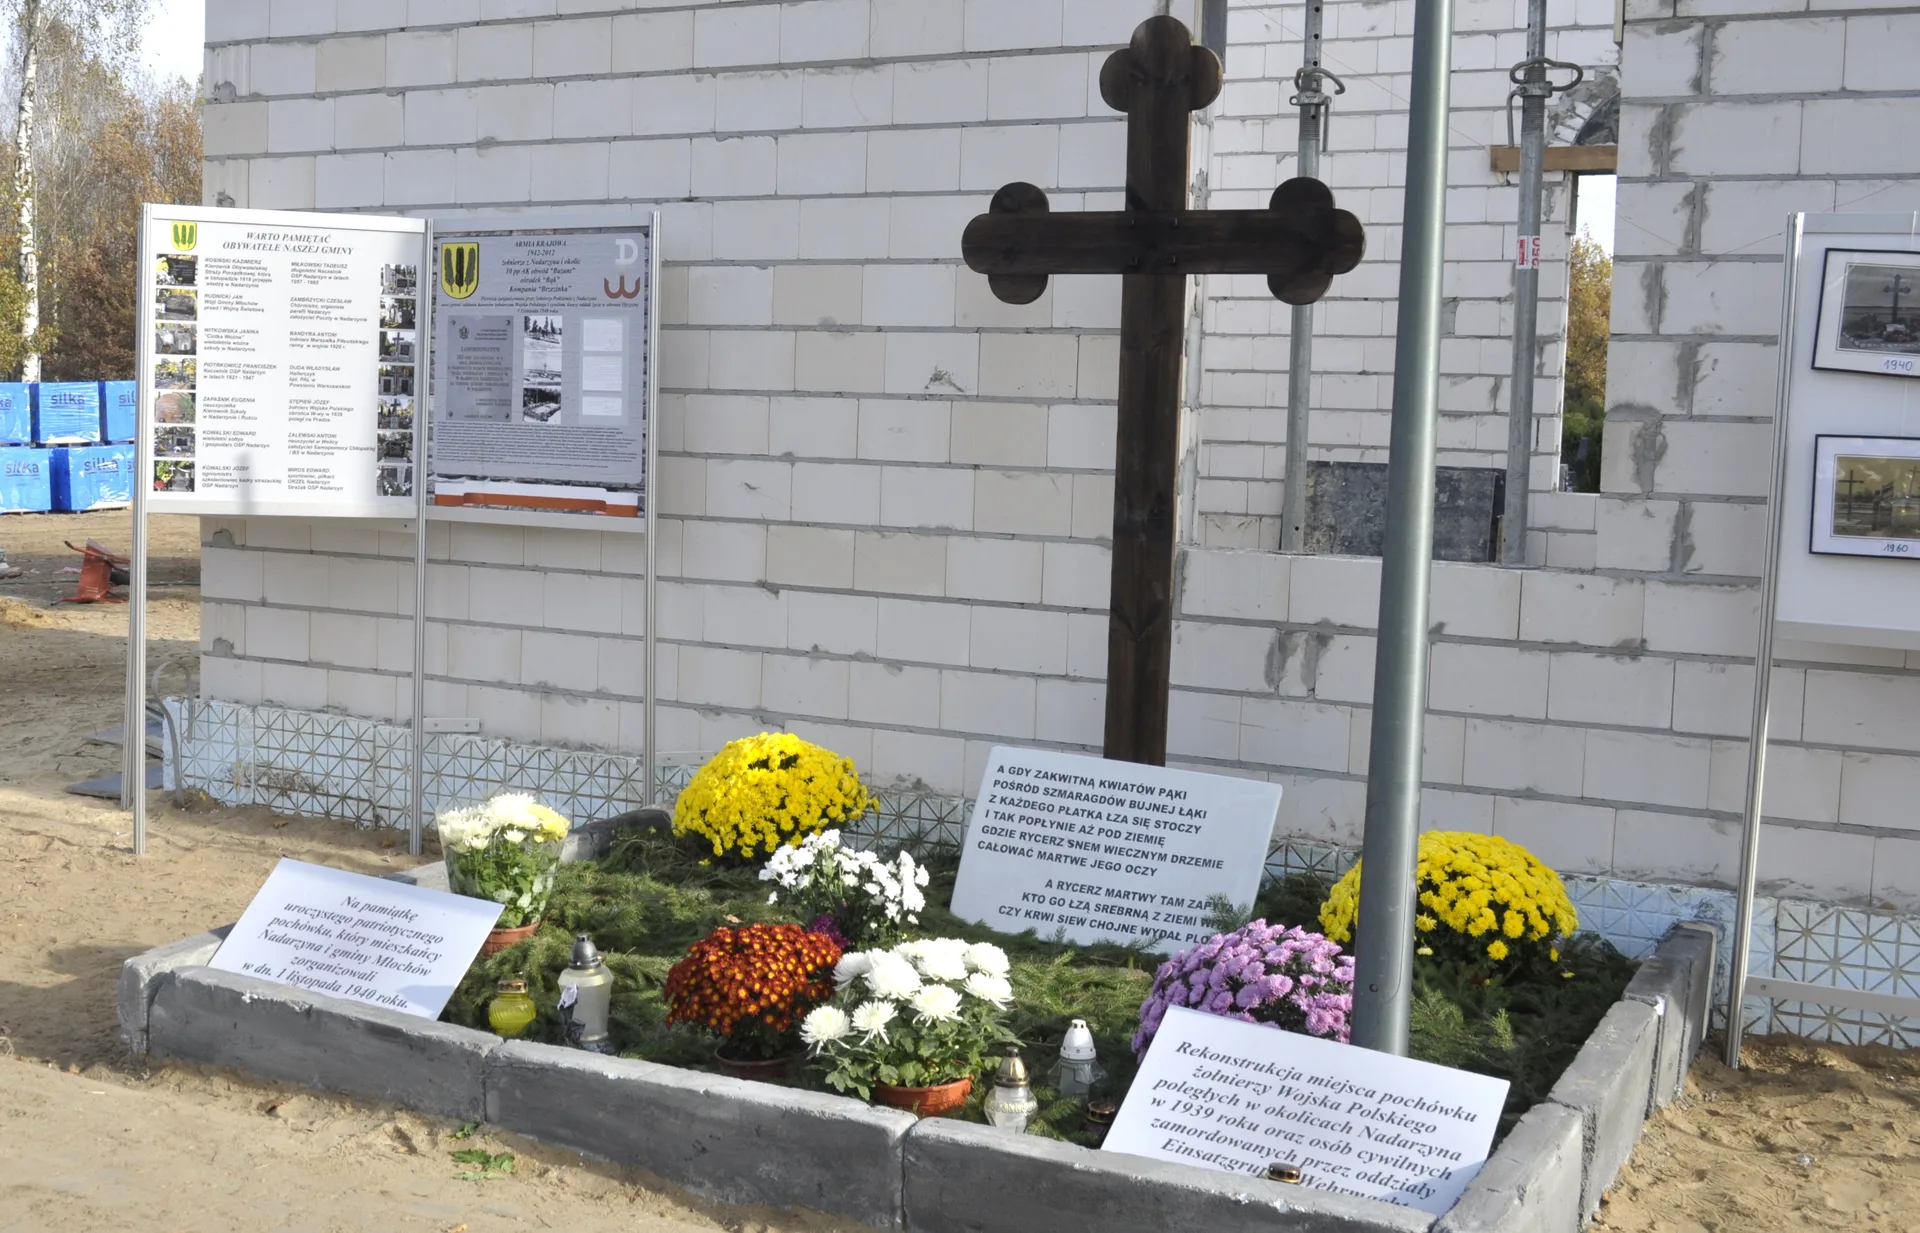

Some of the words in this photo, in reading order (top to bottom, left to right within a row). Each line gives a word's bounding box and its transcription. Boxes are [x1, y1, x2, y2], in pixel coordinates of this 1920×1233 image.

[222, 241, 280, 251] OBYWATELE
[283, 244, 319, 253] NASZEJ
[321, 246, 353, 254] GMINY
[246, 232, 280, 240] WARTO
[282, 233, 331, 244] PAMIĘTAĆ
[1883, 359, 1913, 371] 1940
[51, 392, 85, 405] silka
[5, 461, 39, 473] silka
[1883, 543, 1909, 552] 1960
[992, 779, 1039, 794] POŚRÓD
[1042, 786, 1126, 807] SZMARAGDÓW
[1128, 799, 1175, 814] BUJNEJ
[1178, 806, 1207, 820] ŁĄKI
[996, 764, 1004, 773] A
[1008, 766, 1031, 776] GDY
[1033, 769, 1095, 789] ZAKWITNĄ
[1098, 779, 1155, 795] KWIATÓW
[1158, 787, 1187, 800] PĄKI
[985, 809, 989, 818] I
[993, 810, 1015, 822] TAK
[1018, 814, 1076, 832] POPŁYNIE
[1077, 824, 1094, 835] AŻ
[1097, 827, 1121, 839] POD
[1124, 831, 1165, 848] ZIEMIĘ
[988, 794, 997, 803] Z
[999, 796, 1055, 813] KAŻDEGO
[1057, 805, 1102, 820] PŁATKA
[1105, 812, 1128, 824] ŁZA
[1131, 816, 1151, 829] SIĘ
[1153, 819, 1201, 834] STOCZY
[977, 840, 1034, 858] CAŁOWAĆ
[1036, 850, 1087, 866] MARTWE
[1089, 859, 1121, 871] JEGO
[1124, 864, 1157, 876] OCZY
[981, 824, 1016, 838] GDZIE
[1018, 831, 1065, 847] RYCERZ
[1066, 839, 1100, 852] SNEM
[1104, 844, 1168, 862] WIECZNYM
[1170, 854, 1224, 869] DRZEMIE
[340, 895, 359, 909] Na
[358, 902, 419, 923] pamiątkę
[1021, 891, 1045, 904] KTO
[1048, 896, 1065, 907] GO
[1068, 899, 1090, 913] ŁZĄ
[1093, 902, 1148, 921] SREBRNĄ
[1151, 911, 1161, 921] Z
[1162, 912, 1197, 926] ZIEMI
[1044, 878, 1052, 888] A
[1056, 880, 1102, 896] RYCERZ
[1104, 887, 1157, 903] MARTWY
[1160, 895, 1185, 907] TAM
[267, 916, 333, 938] pochówku,
[336, 928, 369, 947] który
[369, 939, 442, 964] mieszkańcy
[284, 903, 354, 925] uroczystego
[352, 917, 444, 945] patriotycznego
[998, 905, 1021, 916] CZY
[1024, 909, 1054, 922] KRWI
[1056, 914, 1087, 926] SIEW
[1088, 918, 1137, 934] CHOJNE
[1140, 926, 1181, 941] WYDAŁ
[258, 928, 324, 952] Nadarzyna
[323, 943, 332, 953] i
[329, 948, 371, 964] gminy
[373, 954, 431, 977] Młochów
[290, 956, 378, 982] zorganizowali
[242, 962, 253, 970] w
[253, 963, 272, 976] dn.
[276, 968, 287, 979] 1
[286, 969, 343, 992] listopada
[344, 983, 377, 1000] 1940
[376, 993, 408, 1008] roku.
[1175, 1041, 1304, 1082] Rekonstrukcja
[1307, 1073, 1377, 1099] miejsca
[1378, 1092, 1478, 1122] pochówku
[1192, 1065, 1272, 1096] żołnierzy
[1277, 1084, 1342, 1112] Wojska
[1346, 1102, 1437, 1135] Polskiego
[1151, 1097, 1166, 1107] w
[1169, 1099, 1215, 1119] 1939
[1217, 1113, 1260, 1132] roku
[1264, 1127, 1305, 1145] oraz
[1309, 1137, 1352, 1155] osób
[1357, 1150, 1453, 1180] cywilnych
[1152, 1079, 1240, 1106] poległych
[1246, 1101, 1261, 1111] w
[1264, 1104, 1353, 1135] okolicach
[1357, 1125, 1462, 1161] Nadarzyna
[1150, 1117, 1298, 1163] zamordowanych
[1300, 1156, 1352, 1178] przez
[1355, 1170, 1436, 1199] oddziały
